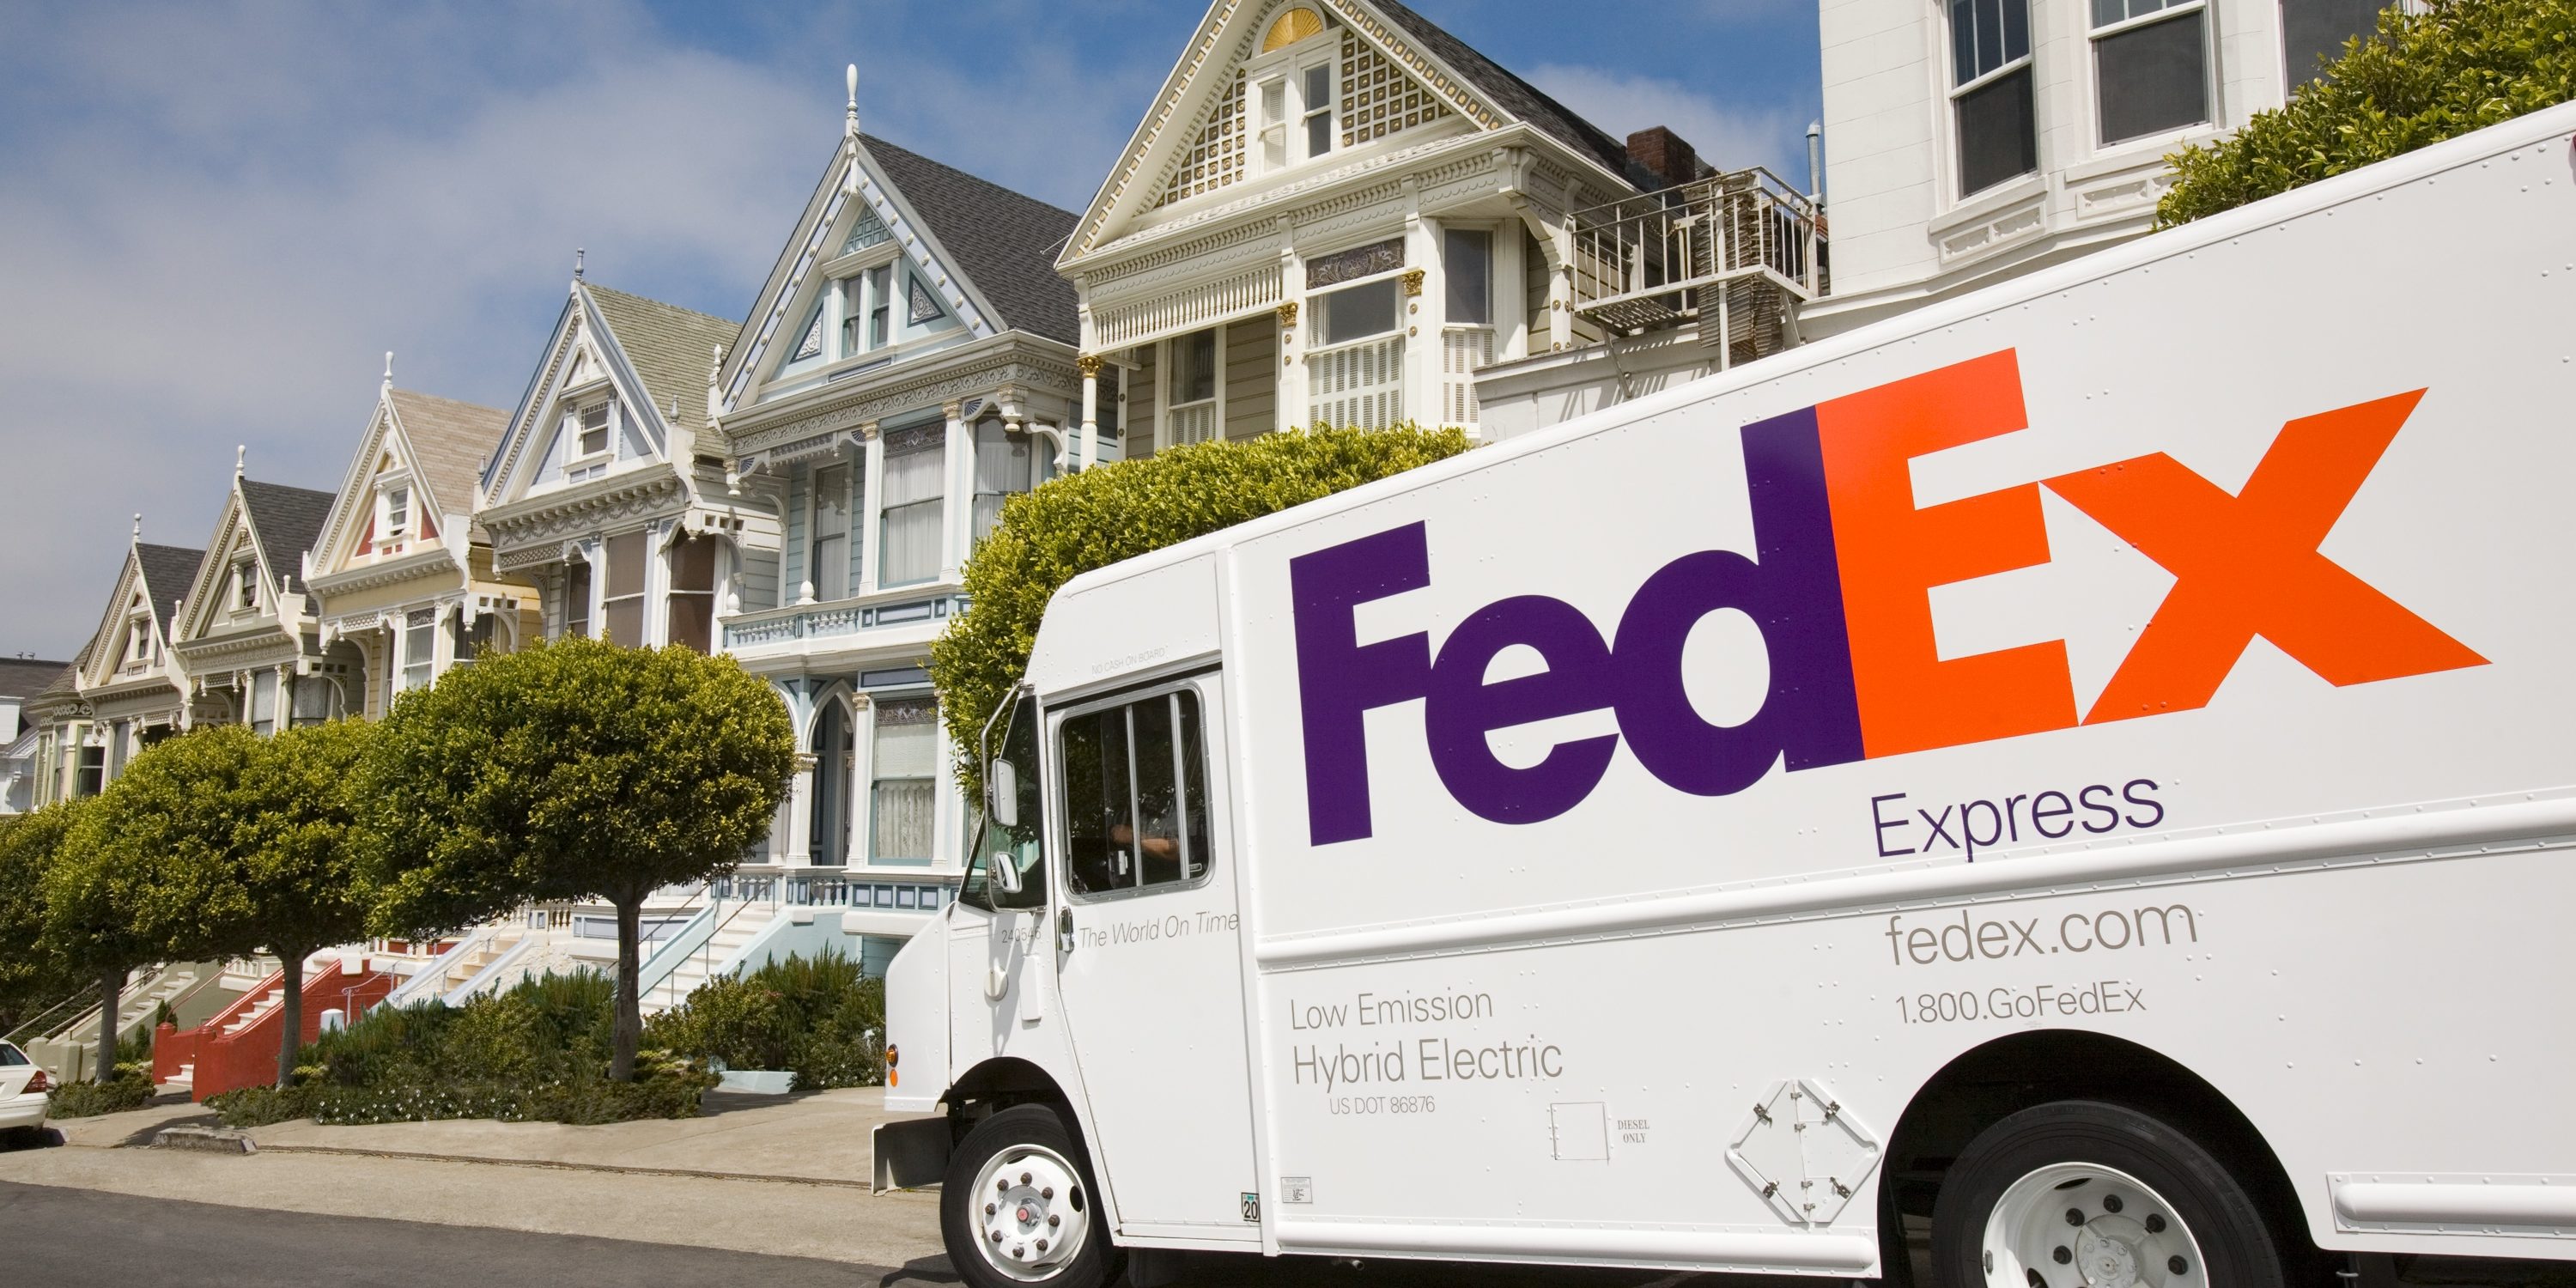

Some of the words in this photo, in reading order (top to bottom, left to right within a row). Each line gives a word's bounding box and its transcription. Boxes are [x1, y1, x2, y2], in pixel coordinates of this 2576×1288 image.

[1290, 347, 2494, 847] FedEx
[1091, 664, 1103, 674] NO
[1104, 659, 1123, 671] CASH
[1125, 655, 1137, 666] ON
[1139, 647, 1165, 662] BOARD
[1871, 778, 2165, 863] Express
[1001, 926, 1042, 944] 240546
[1079, 927, 1108, 949] The
[1112, 918, 1159, 945] World
[1165, 915, 1189, 939] On
[1196, 910, 1239, 934] Time
[1885, 903, 2197, 966] fedex.com
[1291, 999, 1348, 1030] Low
[1358, 987, 1493, 1026] Emission
[1895, 981, 2147, 1024] 1.800.GoFedEx
[1293, 1040, 1406, 1093] Hybrid
[1419, 1033, 1564, 1081] Electric
[1329, 1097, 1351, 1115] US
[1354, 1097, 1386, 1115] DOT
[1390, 1095, 1436, 1114] 86876
[1617, 1119, 1650, 1130] DIESEL
[1623, 1133, 1646, 1144] ONLY
[1243, 1200, 1258, 1220] 20
